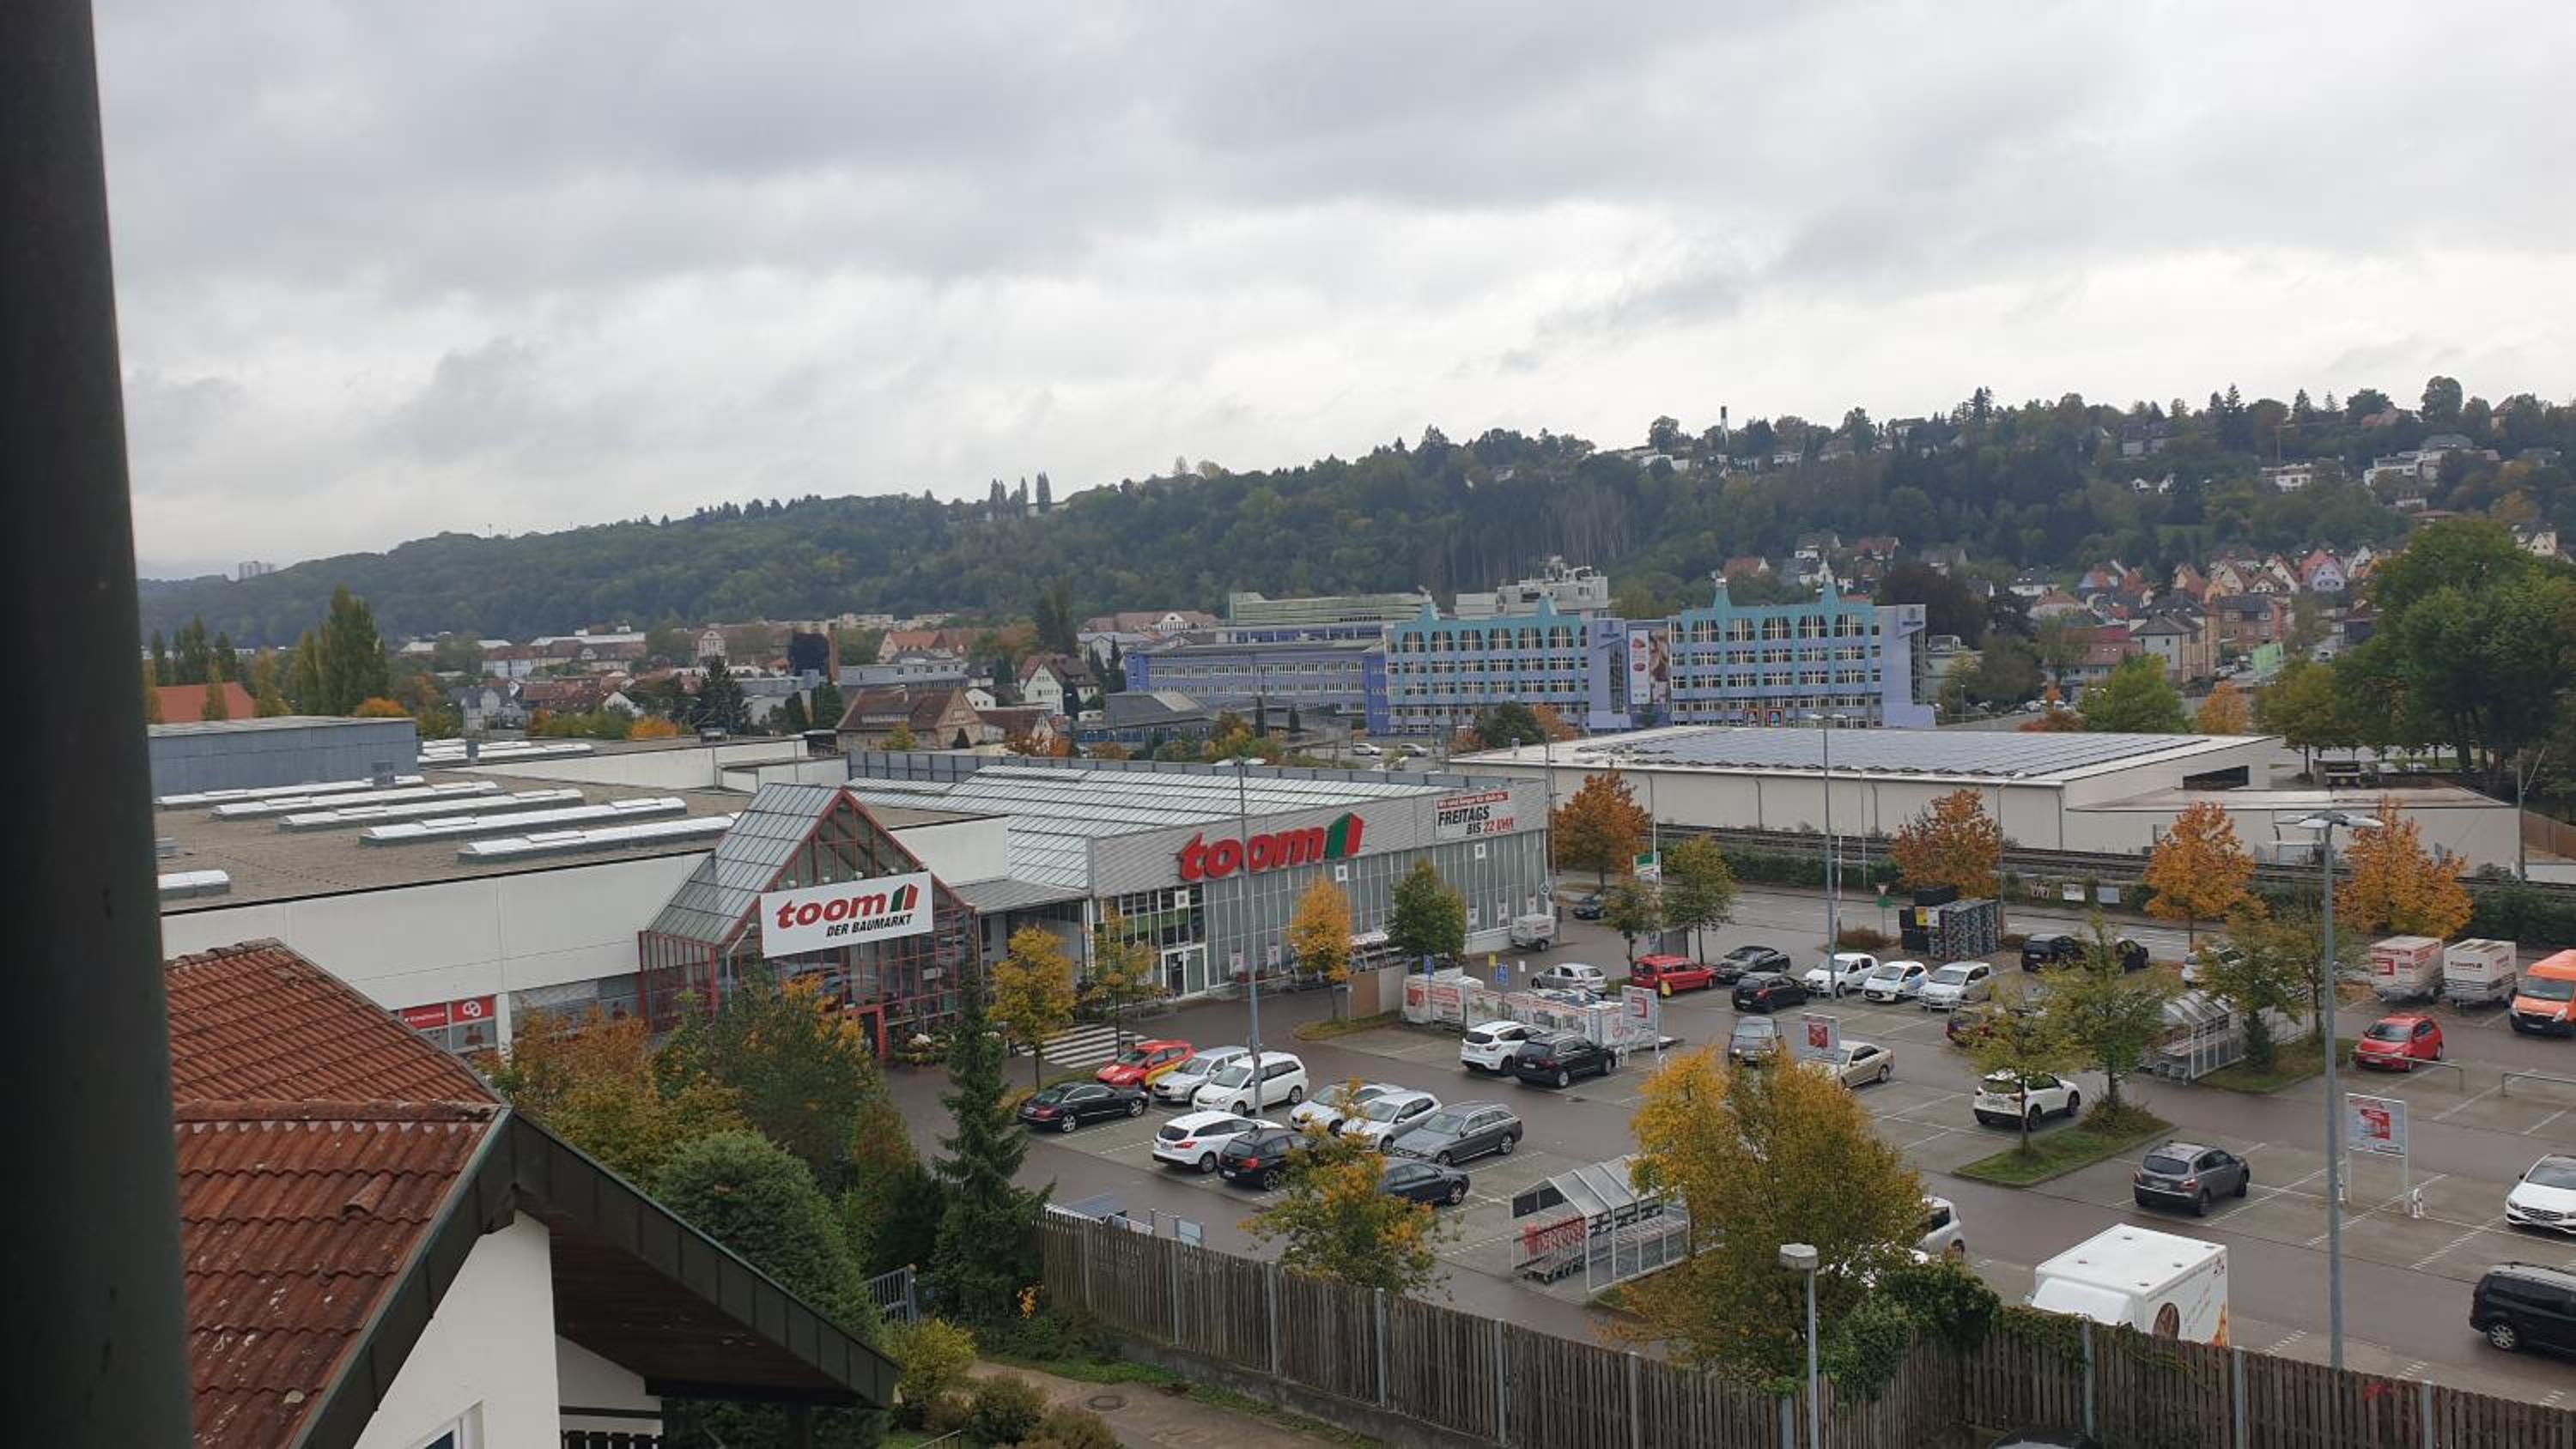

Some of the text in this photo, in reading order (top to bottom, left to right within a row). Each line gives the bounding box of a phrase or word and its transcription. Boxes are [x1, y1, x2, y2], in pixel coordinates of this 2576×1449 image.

[1437, 805, 1490, 826] FREITAGS
[1467, 822, 1481, 834] BIS
[1484, 821, 1494, 833] 22
[1181, 828, 1325, 880] toom
[776, 893, 886, 929] toom
[826, 913, 912, 937] DER BAUMARKT
